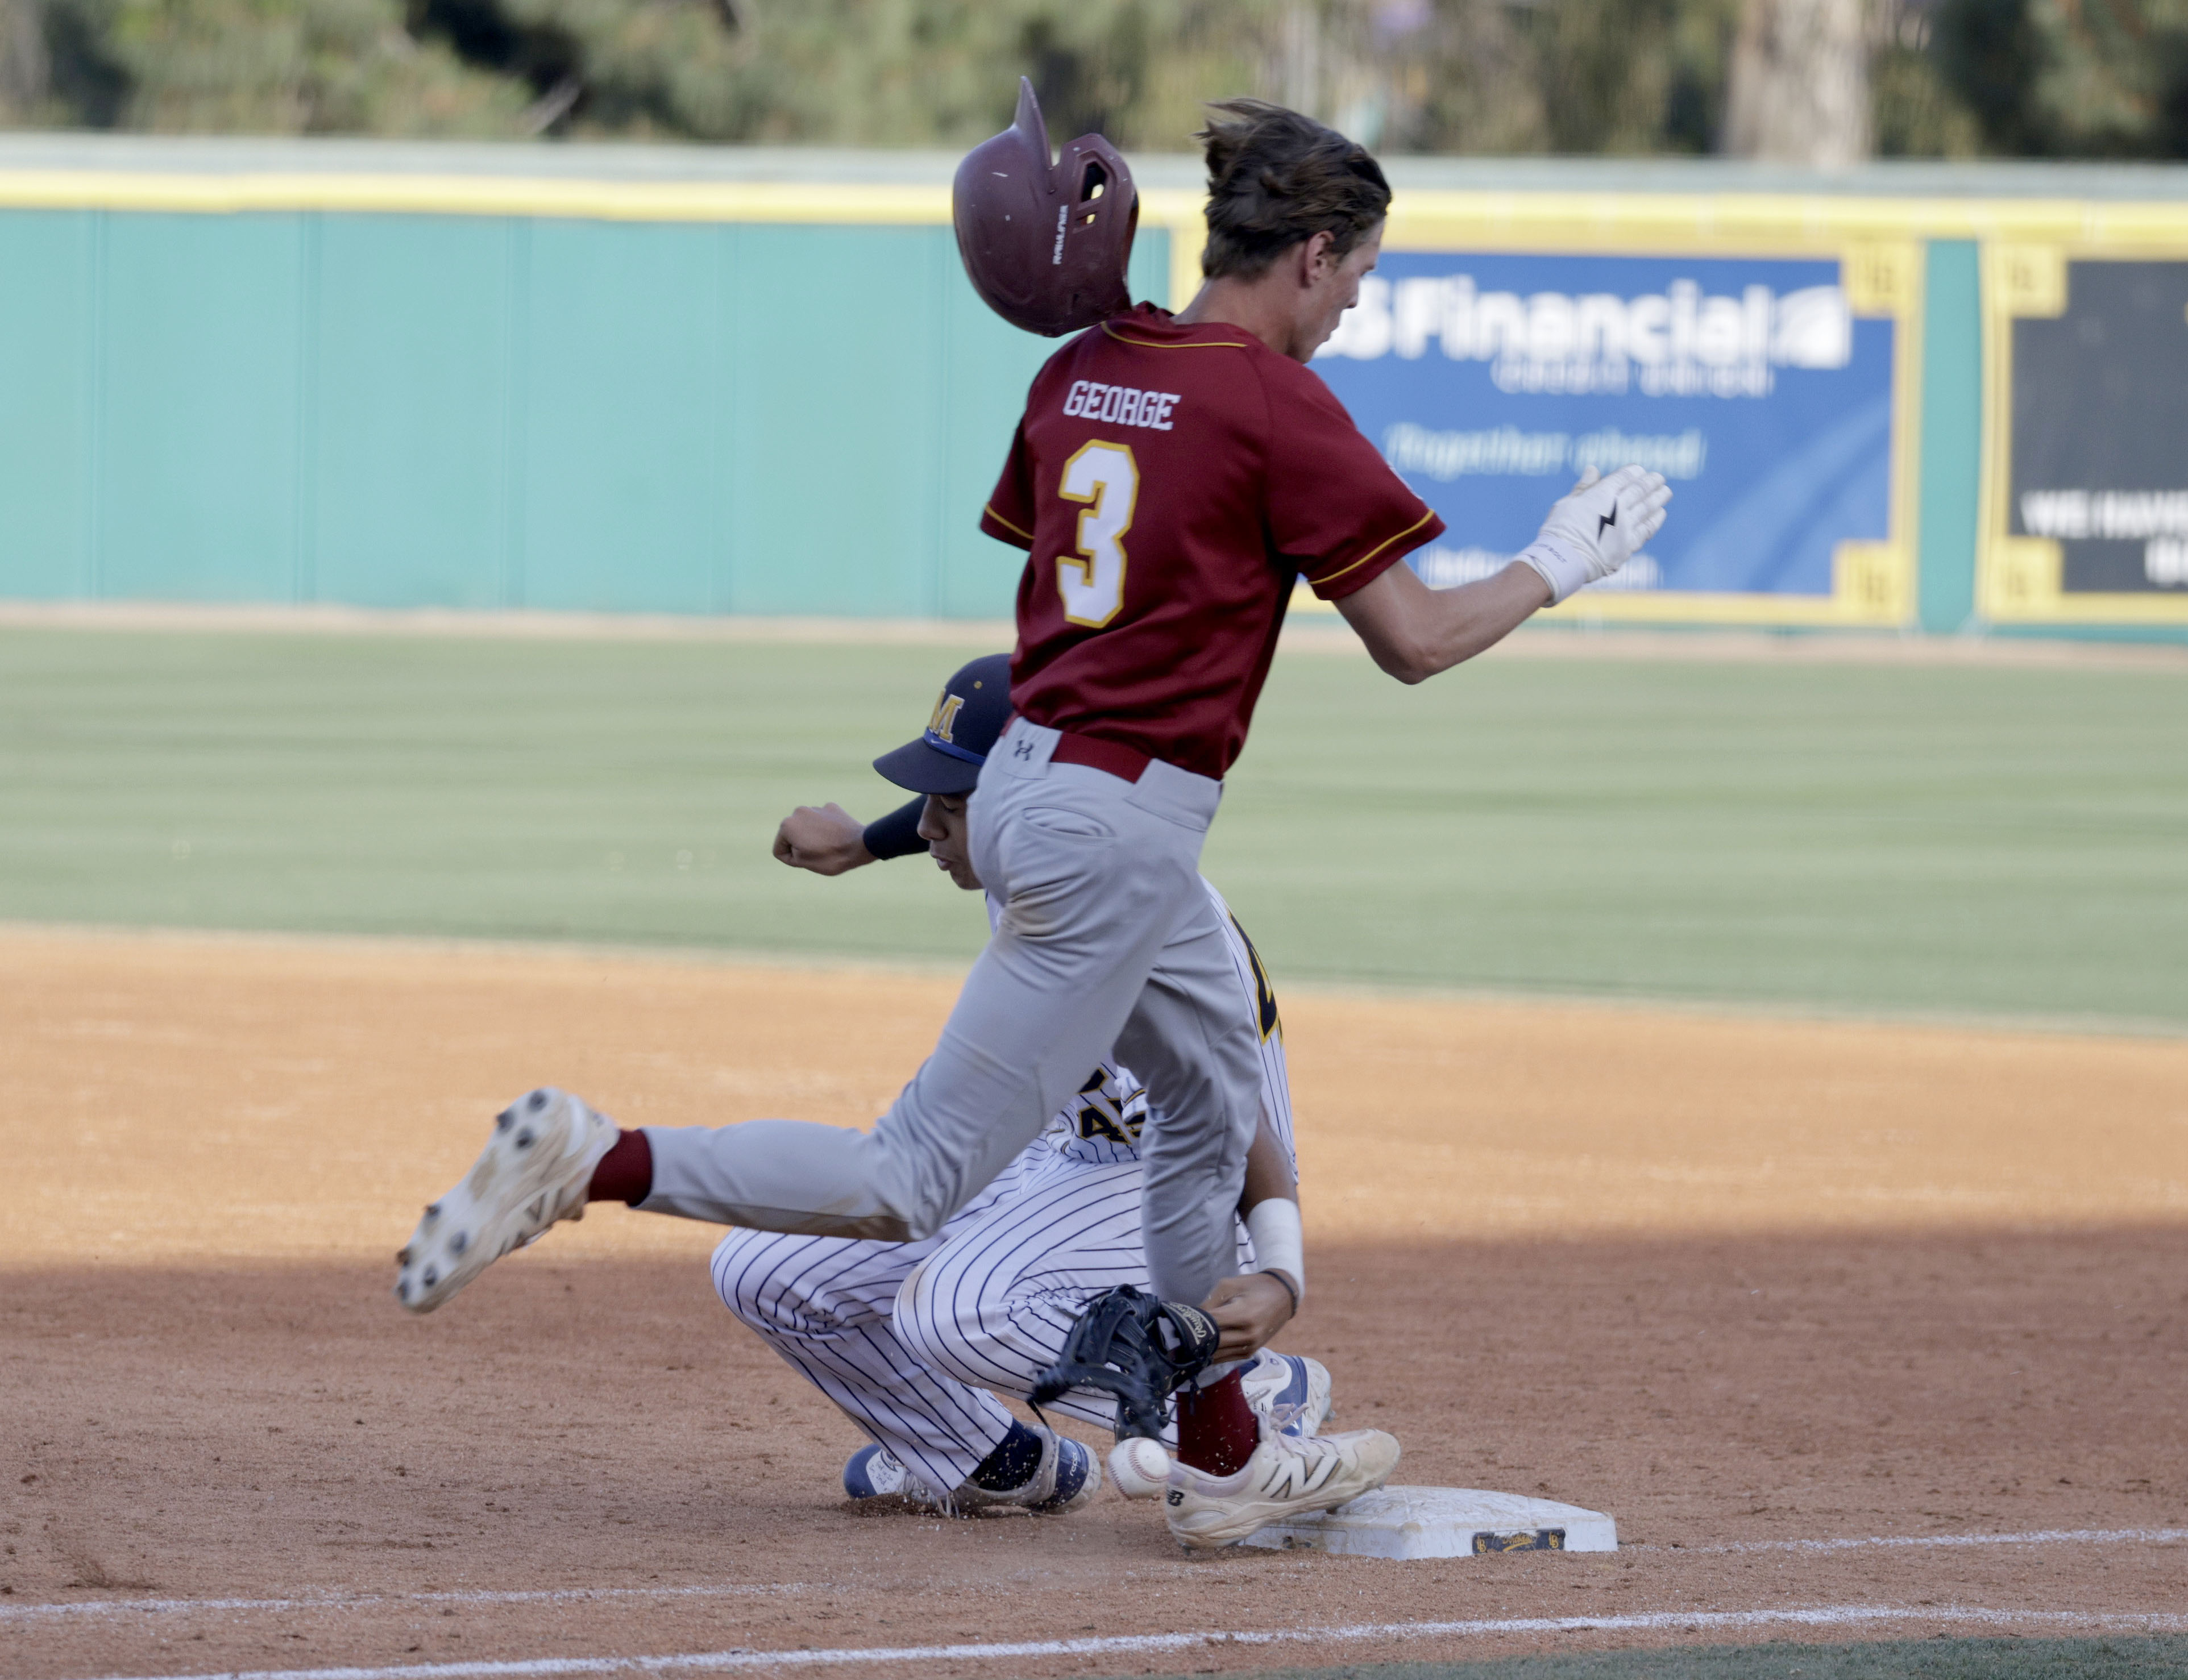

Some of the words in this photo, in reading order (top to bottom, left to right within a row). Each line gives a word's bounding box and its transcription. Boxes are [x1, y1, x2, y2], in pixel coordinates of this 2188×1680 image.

[1394, 275, 1776, 367] Financial
[1062, 380, 1181, 430] GEORGE
[1056, 439, 1140, 629] 3
[928, 687, 965, 743] M
